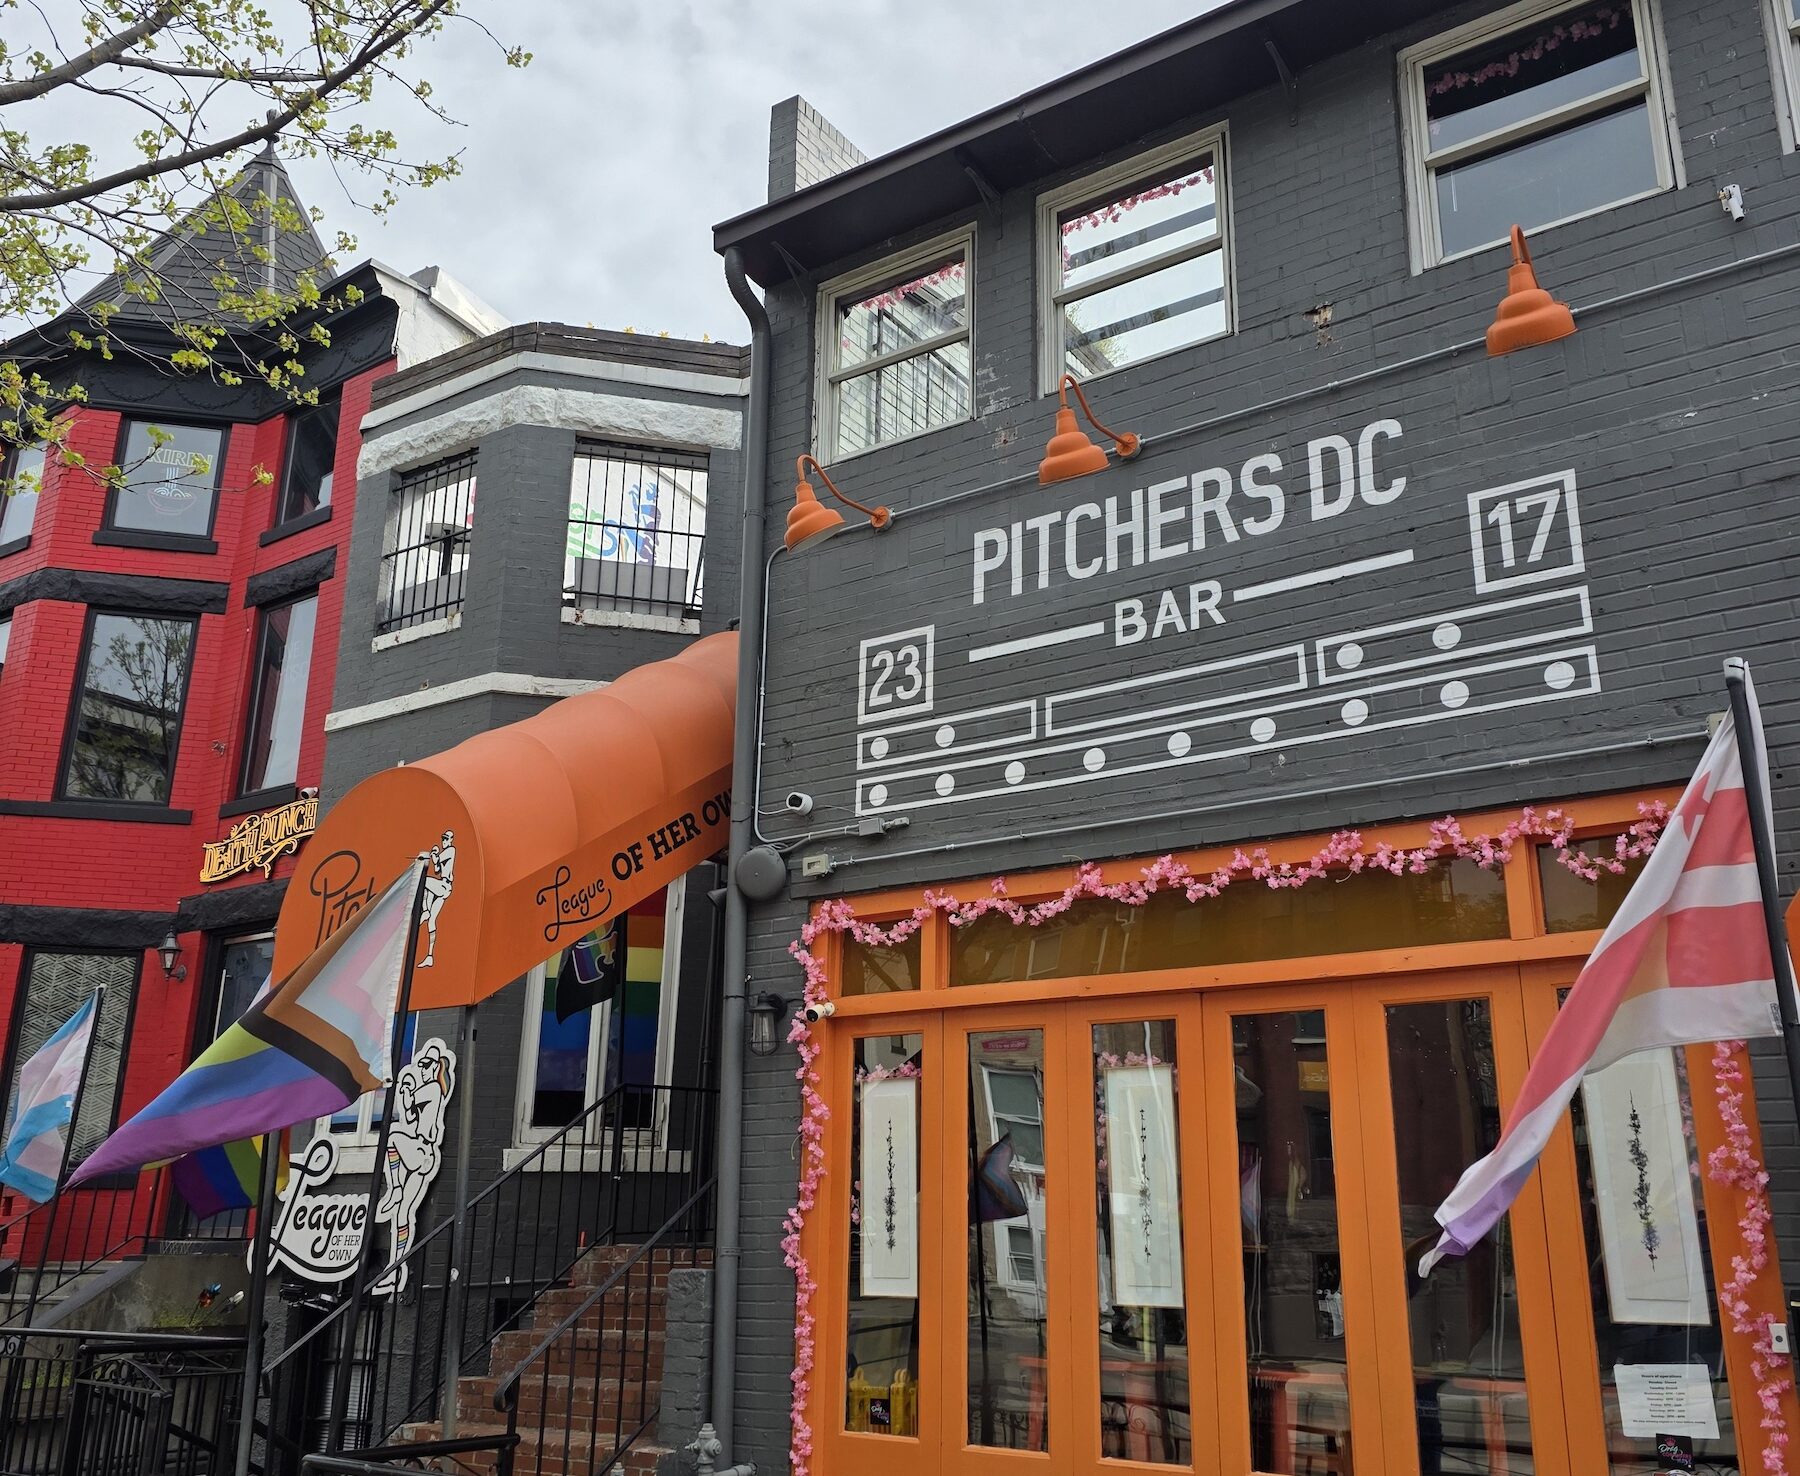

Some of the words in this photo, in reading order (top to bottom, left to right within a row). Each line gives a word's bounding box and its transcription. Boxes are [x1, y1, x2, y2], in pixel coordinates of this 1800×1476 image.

[973, 452, 1286, 605] PITCHERS
[1307, 418, 1407, 522] DC
[1488, 488, 1561, 568] 17
[1115, 580, 1226, 647] BAR
[869, 644, 923, 707] 23
[203, 828, 260, 877] DEATH
[258, 801, 319, 856] PUNCH
[544, 865, 613, 942] League
[611, 842, 645, 881] OF
[647, 812, 702, 862] HER
[702, 787, 733, 827] OW
[269, 1139, 368, 1274] League
[331, 1235, 342, 1246] OF
[345, 1234, 361, 1247] HER
[328, 1249, 352, 1262] OWN
